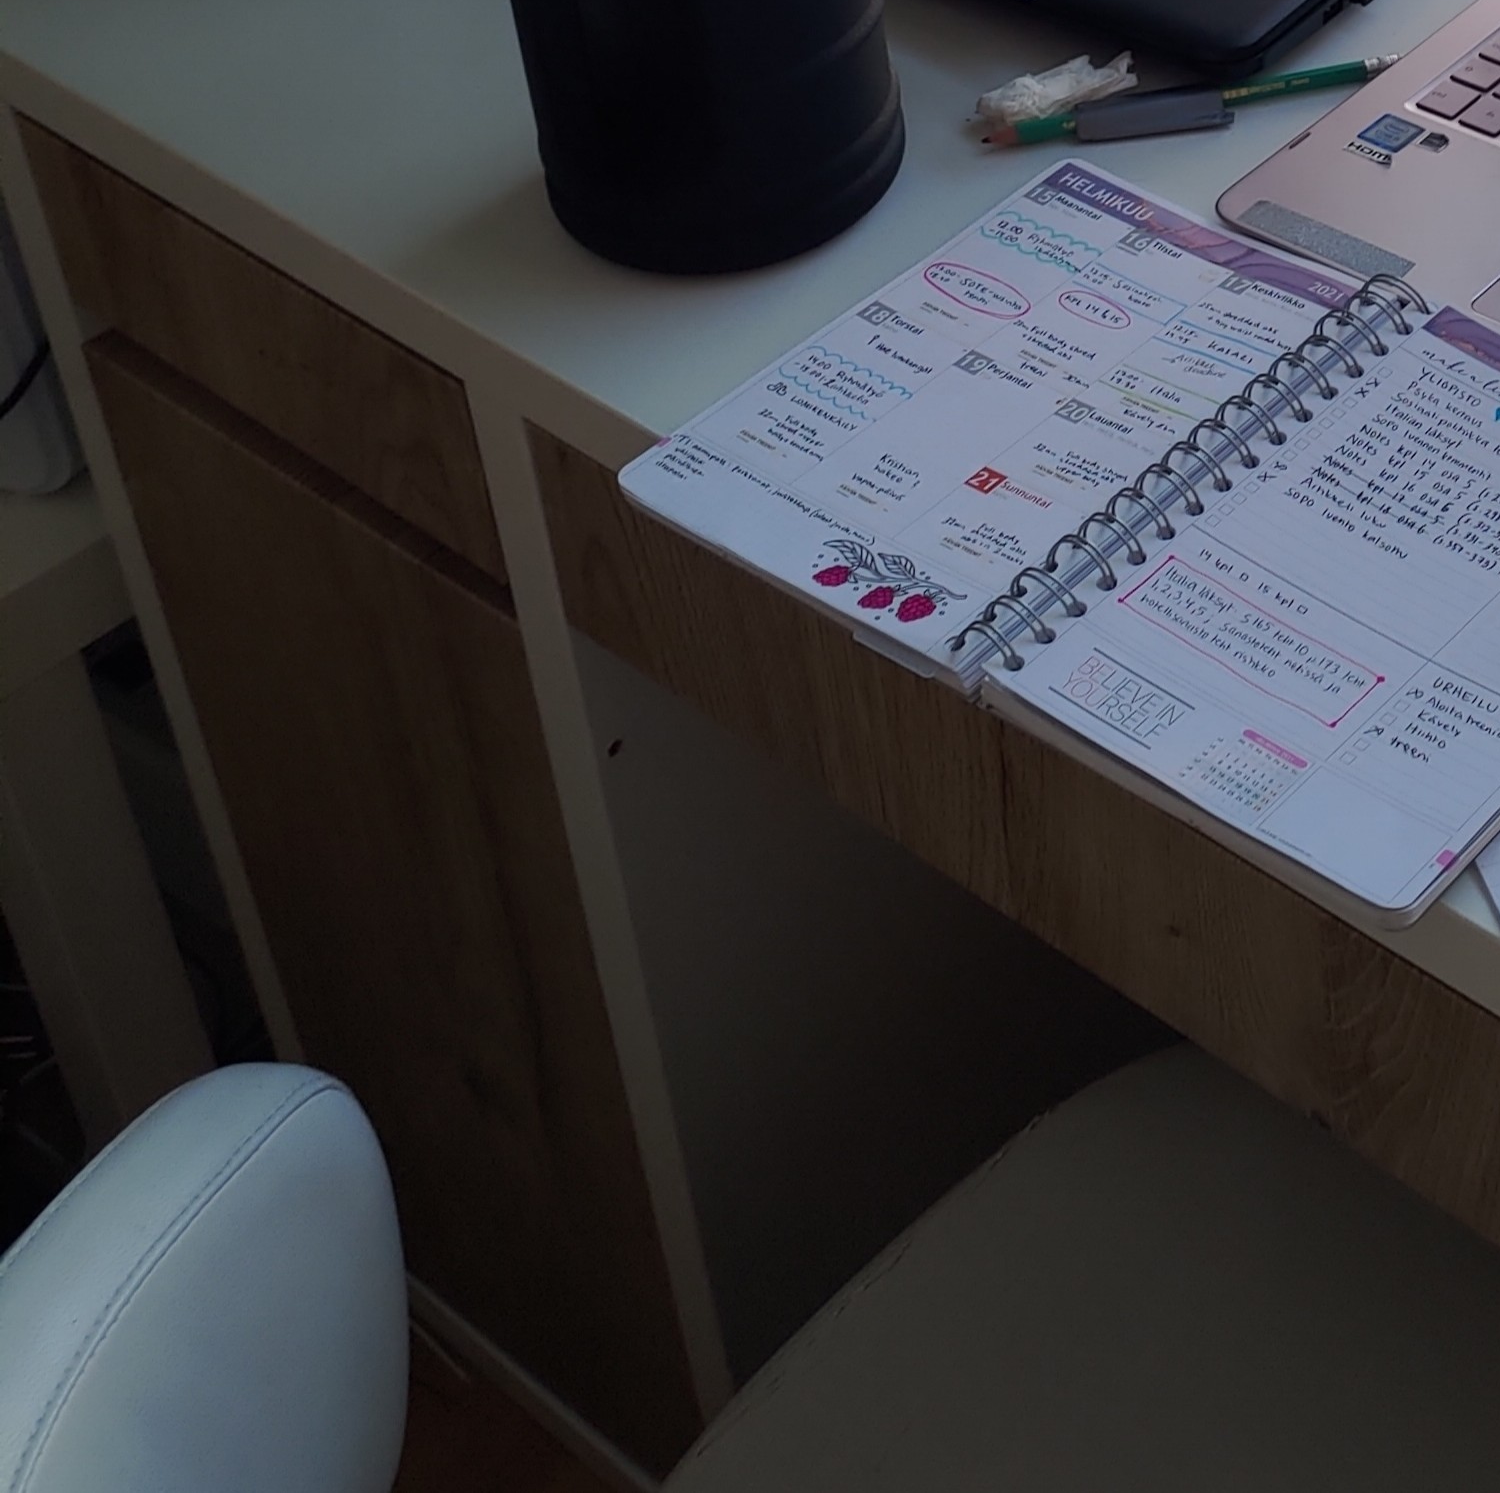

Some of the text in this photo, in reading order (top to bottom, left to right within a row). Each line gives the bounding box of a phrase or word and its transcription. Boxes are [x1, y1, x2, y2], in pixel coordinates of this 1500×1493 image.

[1030, 186, 1102, 220] 15 Maanantai
[1059, 172, 1154, 221] HELMIKUU
[1124, 232, 1183, 259] 16 Tiistai
[1223, 275, 1305, 309] 17 Keskiviikko
[1308, 281, 1344, 302] 2021
[864, 305, 925, 335] 18 Torstai
[960, 355, 1034, 390] 19 Perjantai
[1059, 400, 1133, 436] 20 Lauantai
[967, 470, 1052, 509] 21 Sunnuntai
[1062, 671, 1168, 739] YOURSELF
[1077, 655, 1186, 726] BELIEVE IN
[1432, 676, 1499, 714] URHEILU
